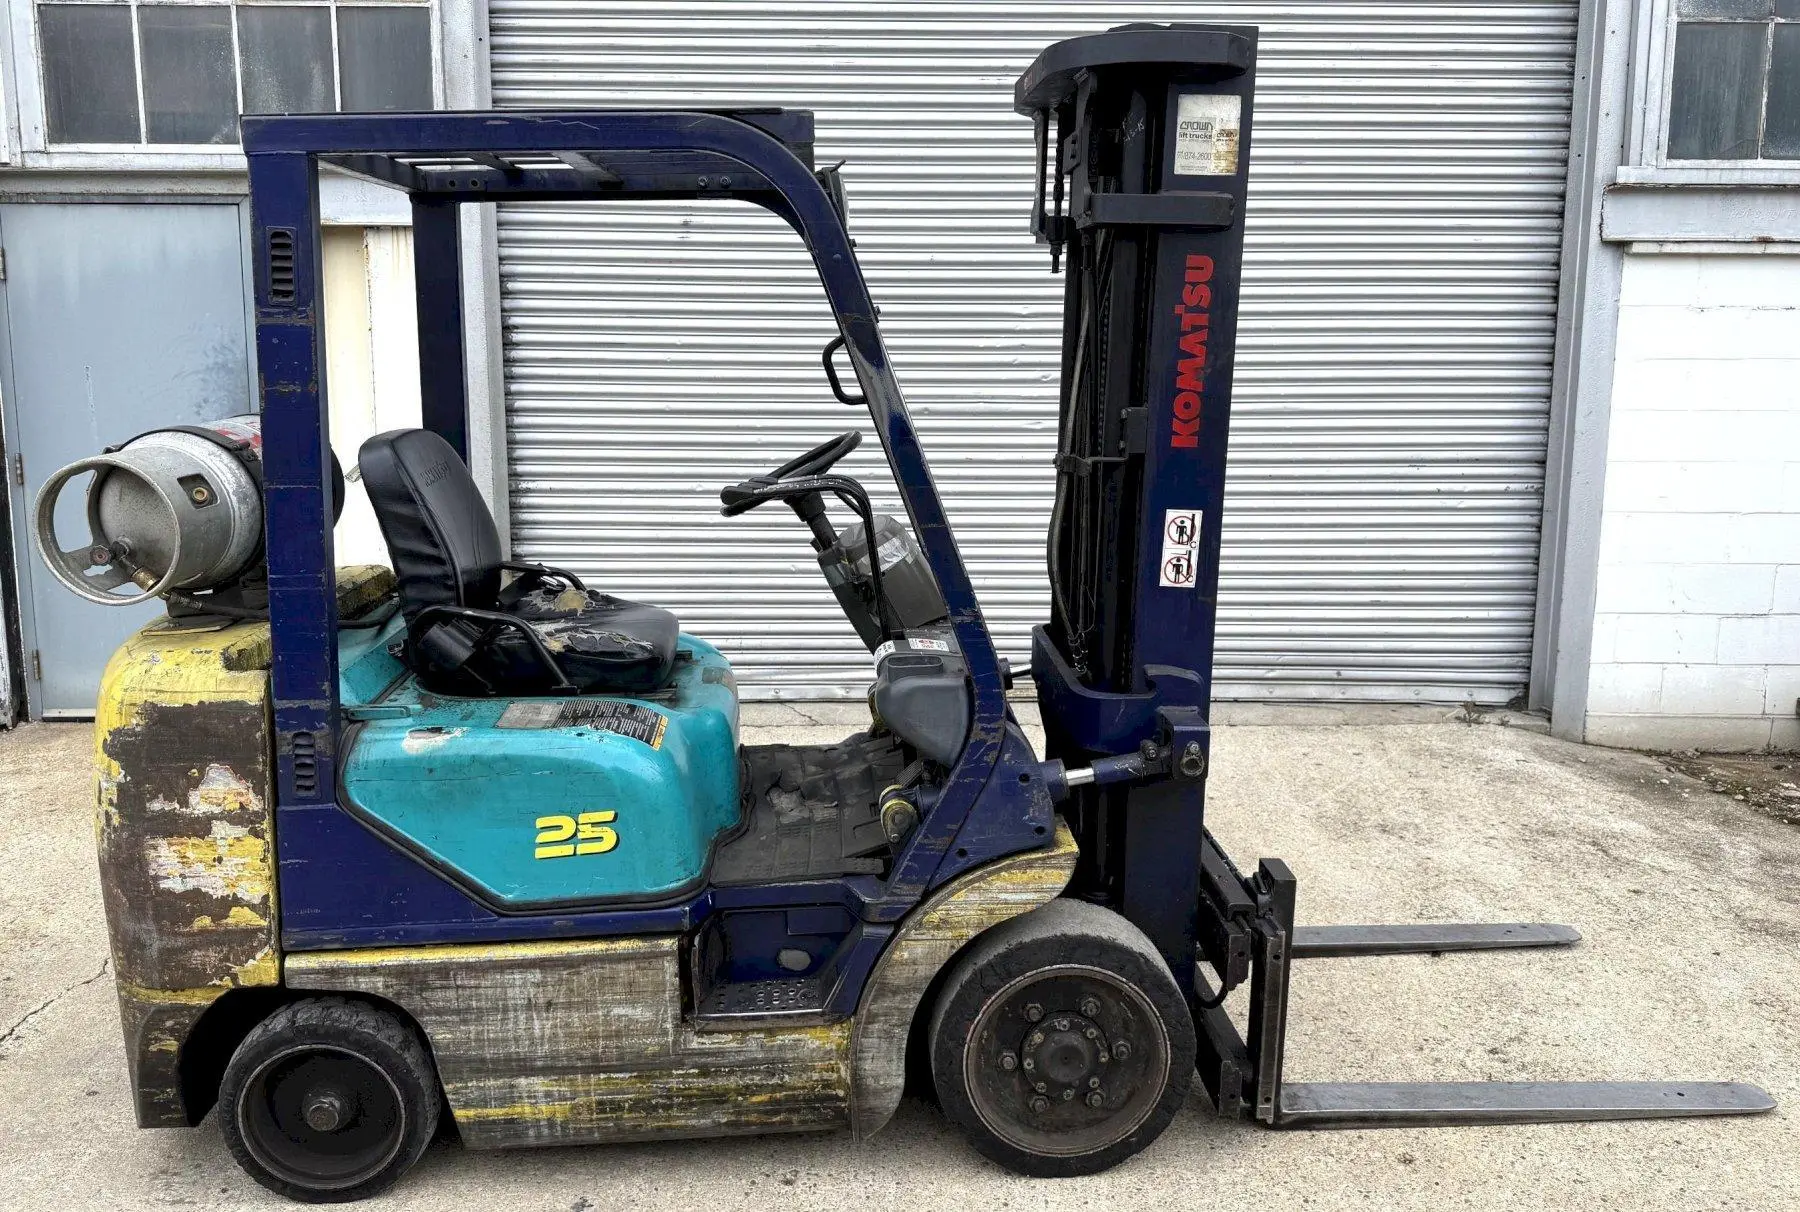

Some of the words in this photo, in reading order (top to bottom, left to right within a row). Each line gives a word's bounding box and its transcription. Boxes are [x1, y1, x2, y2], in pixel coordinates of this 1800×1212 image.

[1189, 132, 1212, 140] trucks
[1171, 254, 1214, 448] KOMATSU
[535, 810, 619, 860] 25
